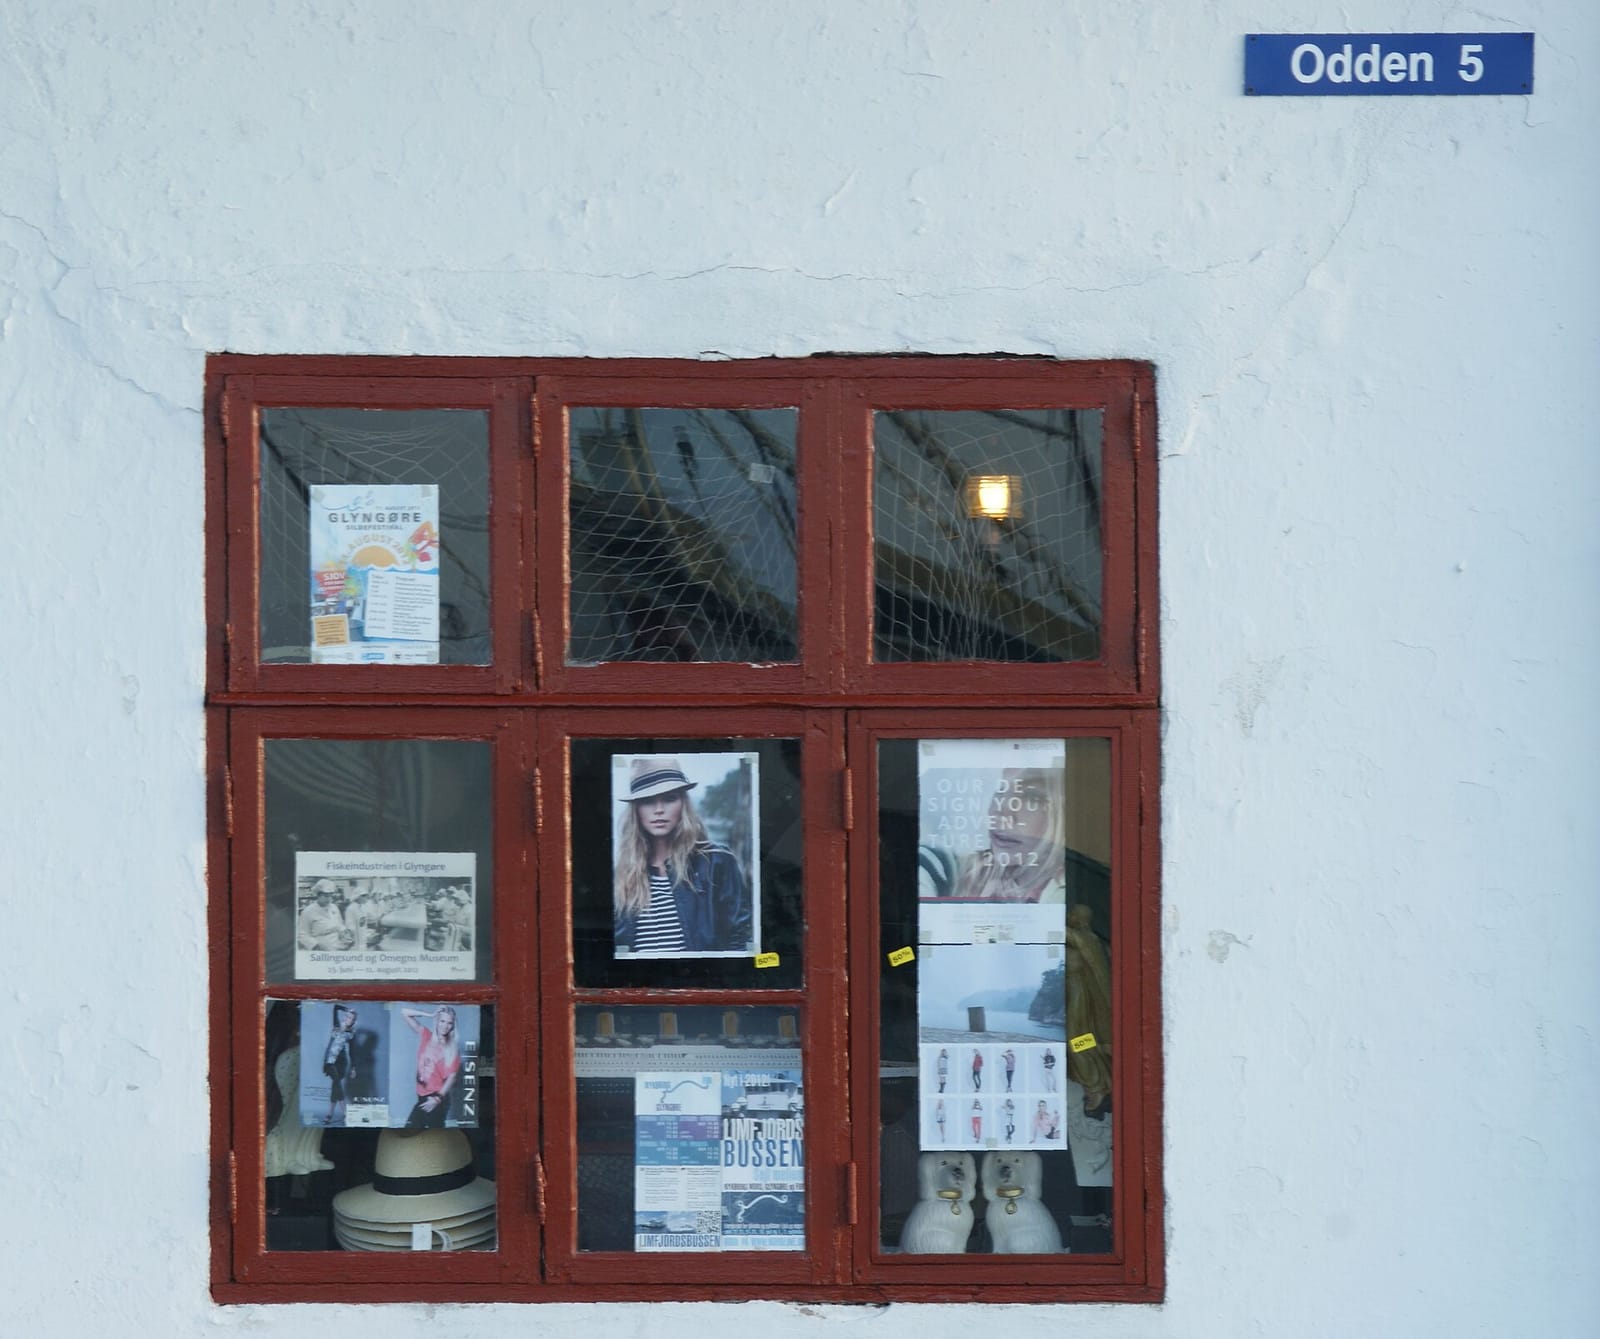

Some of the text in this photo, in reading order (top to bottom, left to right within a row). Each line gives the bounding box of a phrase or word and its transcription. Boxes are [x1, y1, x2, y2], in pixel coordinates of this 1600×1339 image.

[1291, 43, 1484, 84] Odden 5
[328, 512, 422, 523] GLYNGØRE
[937, 778, 1036, 794] OUR DE-
[927, 797, 981, 812] SIGN
[938, 815, 1026, 830] ADVEN-
[928, 834, 985, 849] TURE
[326, 861, 397, 871] Fiskeindustrien
[403, 861, 446, 873] Glyngøre
[983, 852, 1039, 867] 2012
[310, 953, 363, 964] Sallingsund
[366, 955, 377, 964] og
[419, 953, 459, 963] Museum
[723, 1118, 804, 1140] LIMFJORDS
[724, 1139, 804, 1167] BUSSEN
[639, 1234, 721, 1248] LIMFJORDSBUSSEN
